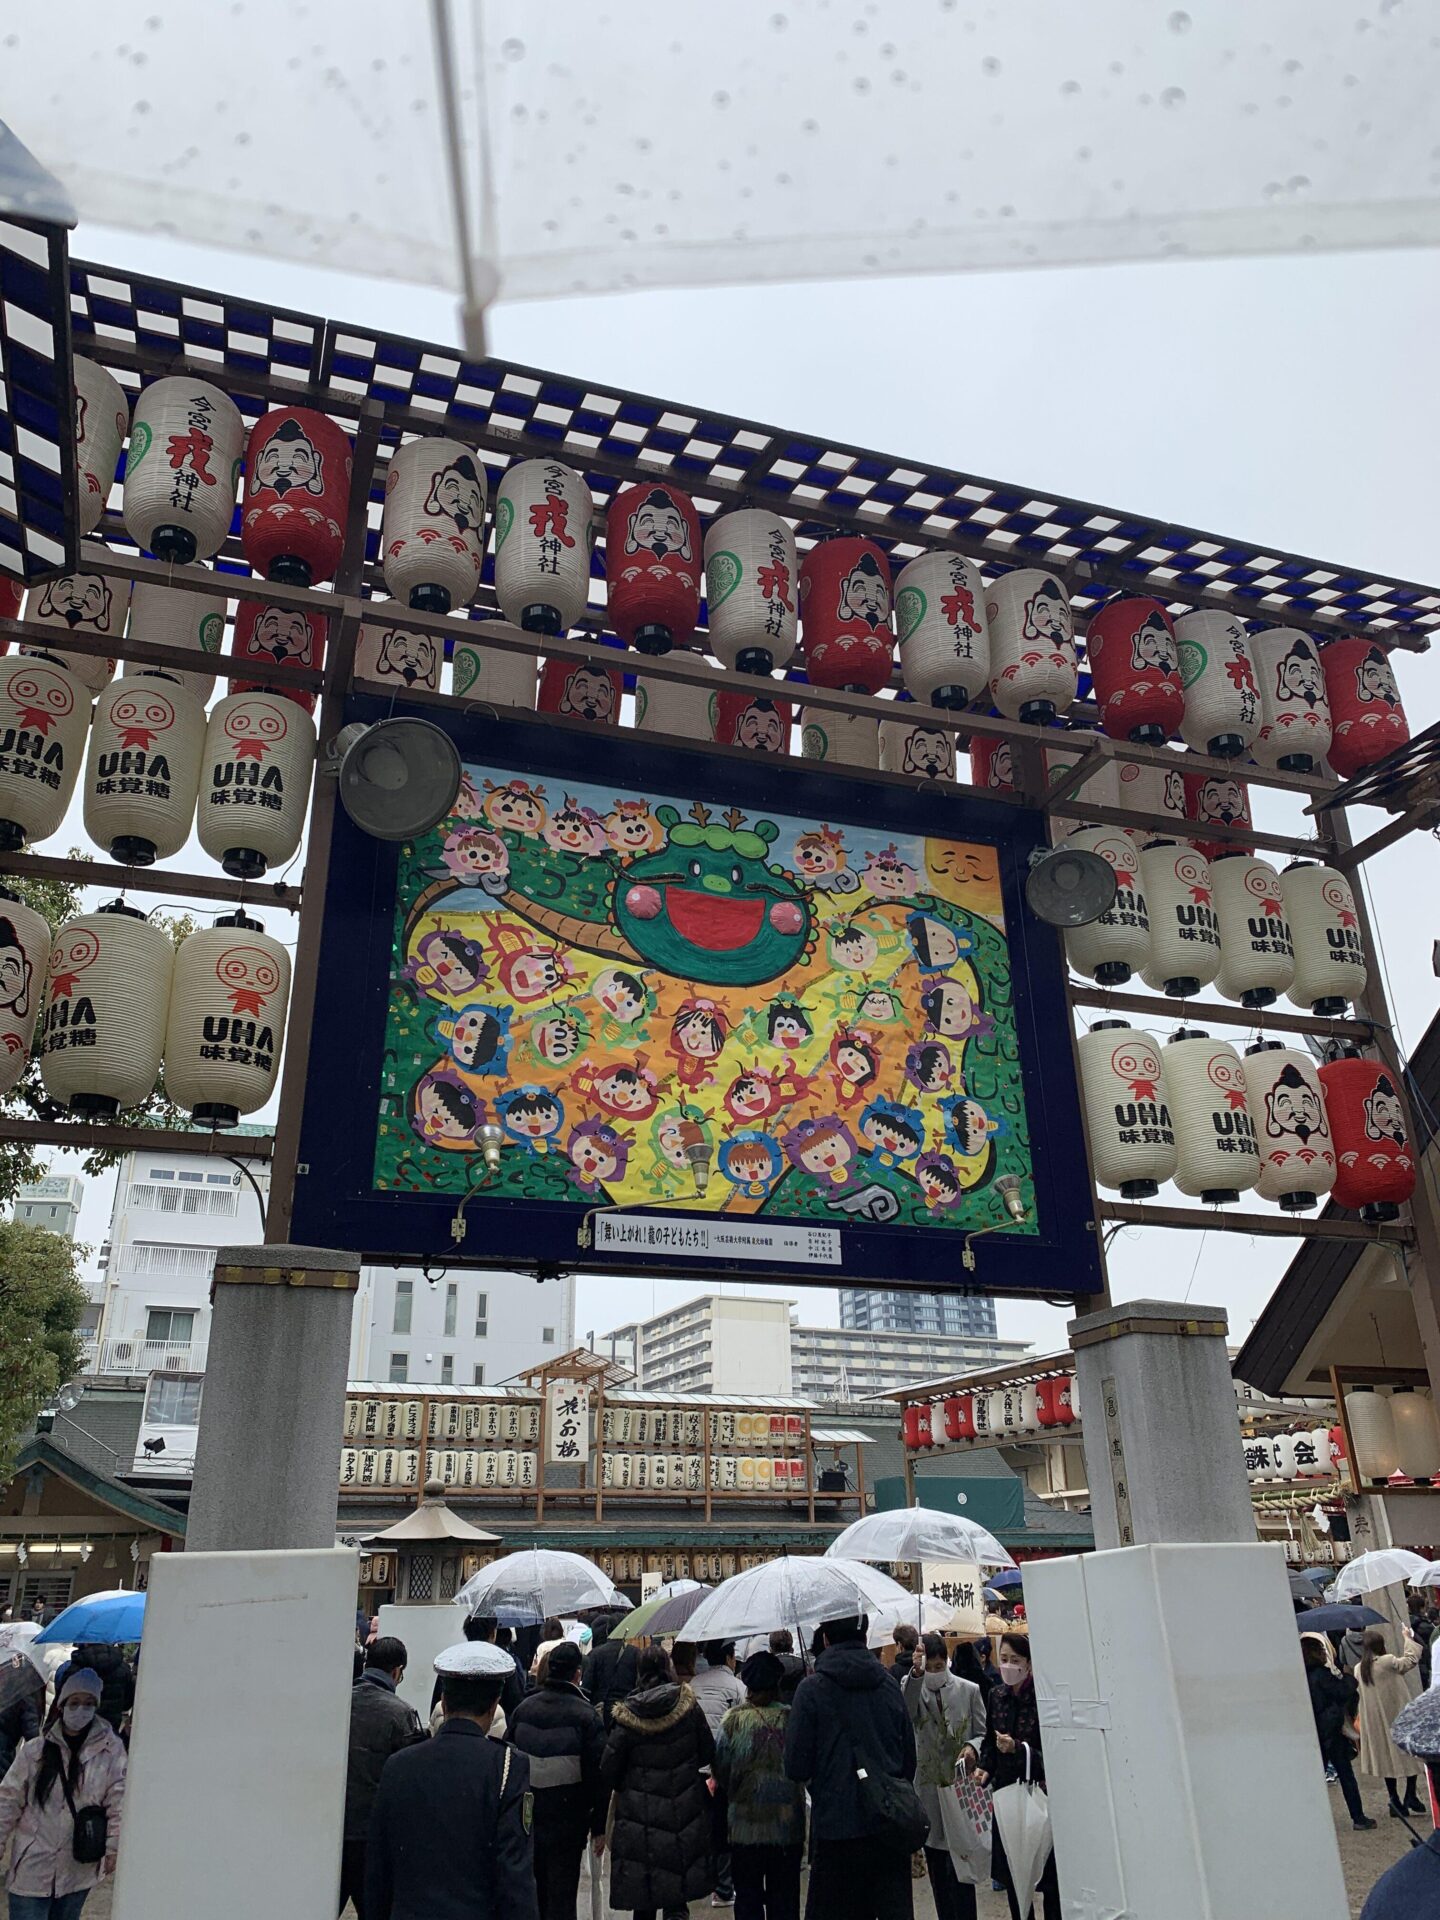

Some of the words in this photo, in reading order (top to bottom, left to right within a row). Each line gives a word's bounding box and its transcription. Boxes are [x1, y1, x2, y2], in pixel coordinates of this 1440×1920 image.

[166, 396, 217, 513] 今宮戎神社
[528, 465, 576, 576] 今宮戎神社
[757, 529, 795, 639] 今宮戎神社
[940, 556, 982, 659] 今宮戎神社
[1224, 625, 1261, 724] 今宮戎神社
[98, 752, 171, 781] UHA
[213, 762, 283, 792] UHA
[96, 777, 170, 799] 味覚糖
[210, 788, 283, 811] 味覚糖
[1326, 928, 1361, 952] UH
[1329, 950, 1366, 968] 味覚
[203, 1016, 274, 1053] UHA
[200, 1045, 273, 1072] 味覚糖
[1115, 1103, 1172, 1128] UHA
[1118, 1128, 1175, 1145] 味覚糖
